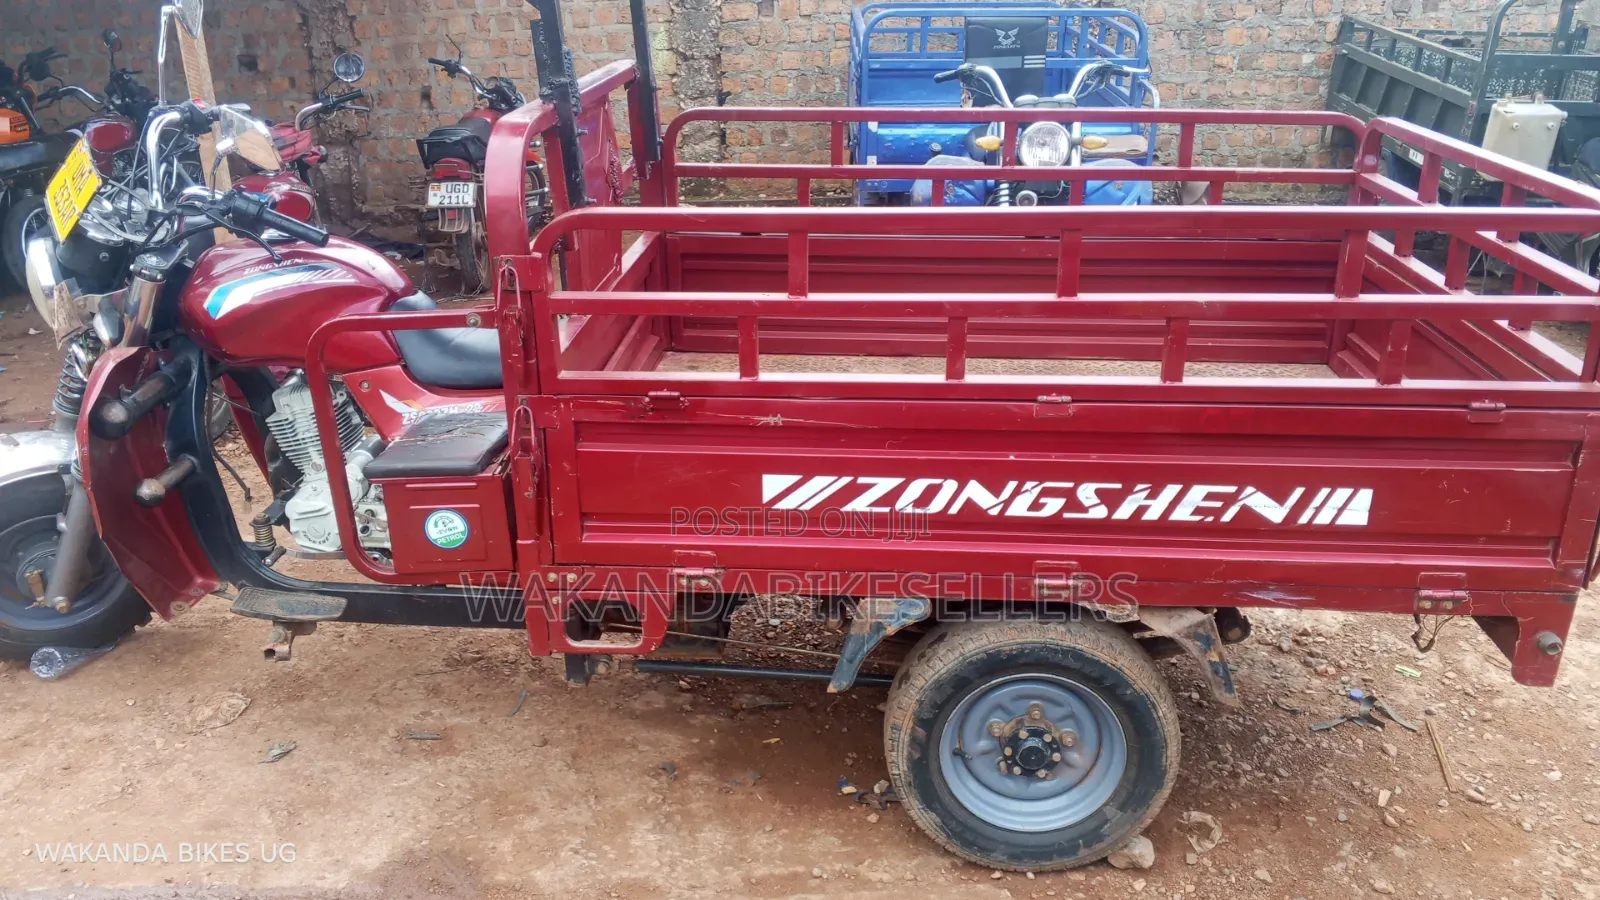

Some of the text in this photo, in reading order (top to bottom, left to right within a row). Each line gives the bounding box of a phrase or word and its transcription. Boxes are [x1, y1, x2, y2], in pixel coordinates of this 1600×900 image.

[445, 184, 469, 193] UGD
[439, 195, 468, 205] 211L
[846, 477, 1302, 524] ZONGSHEN
[437, 533, 464, 544] PETROL
